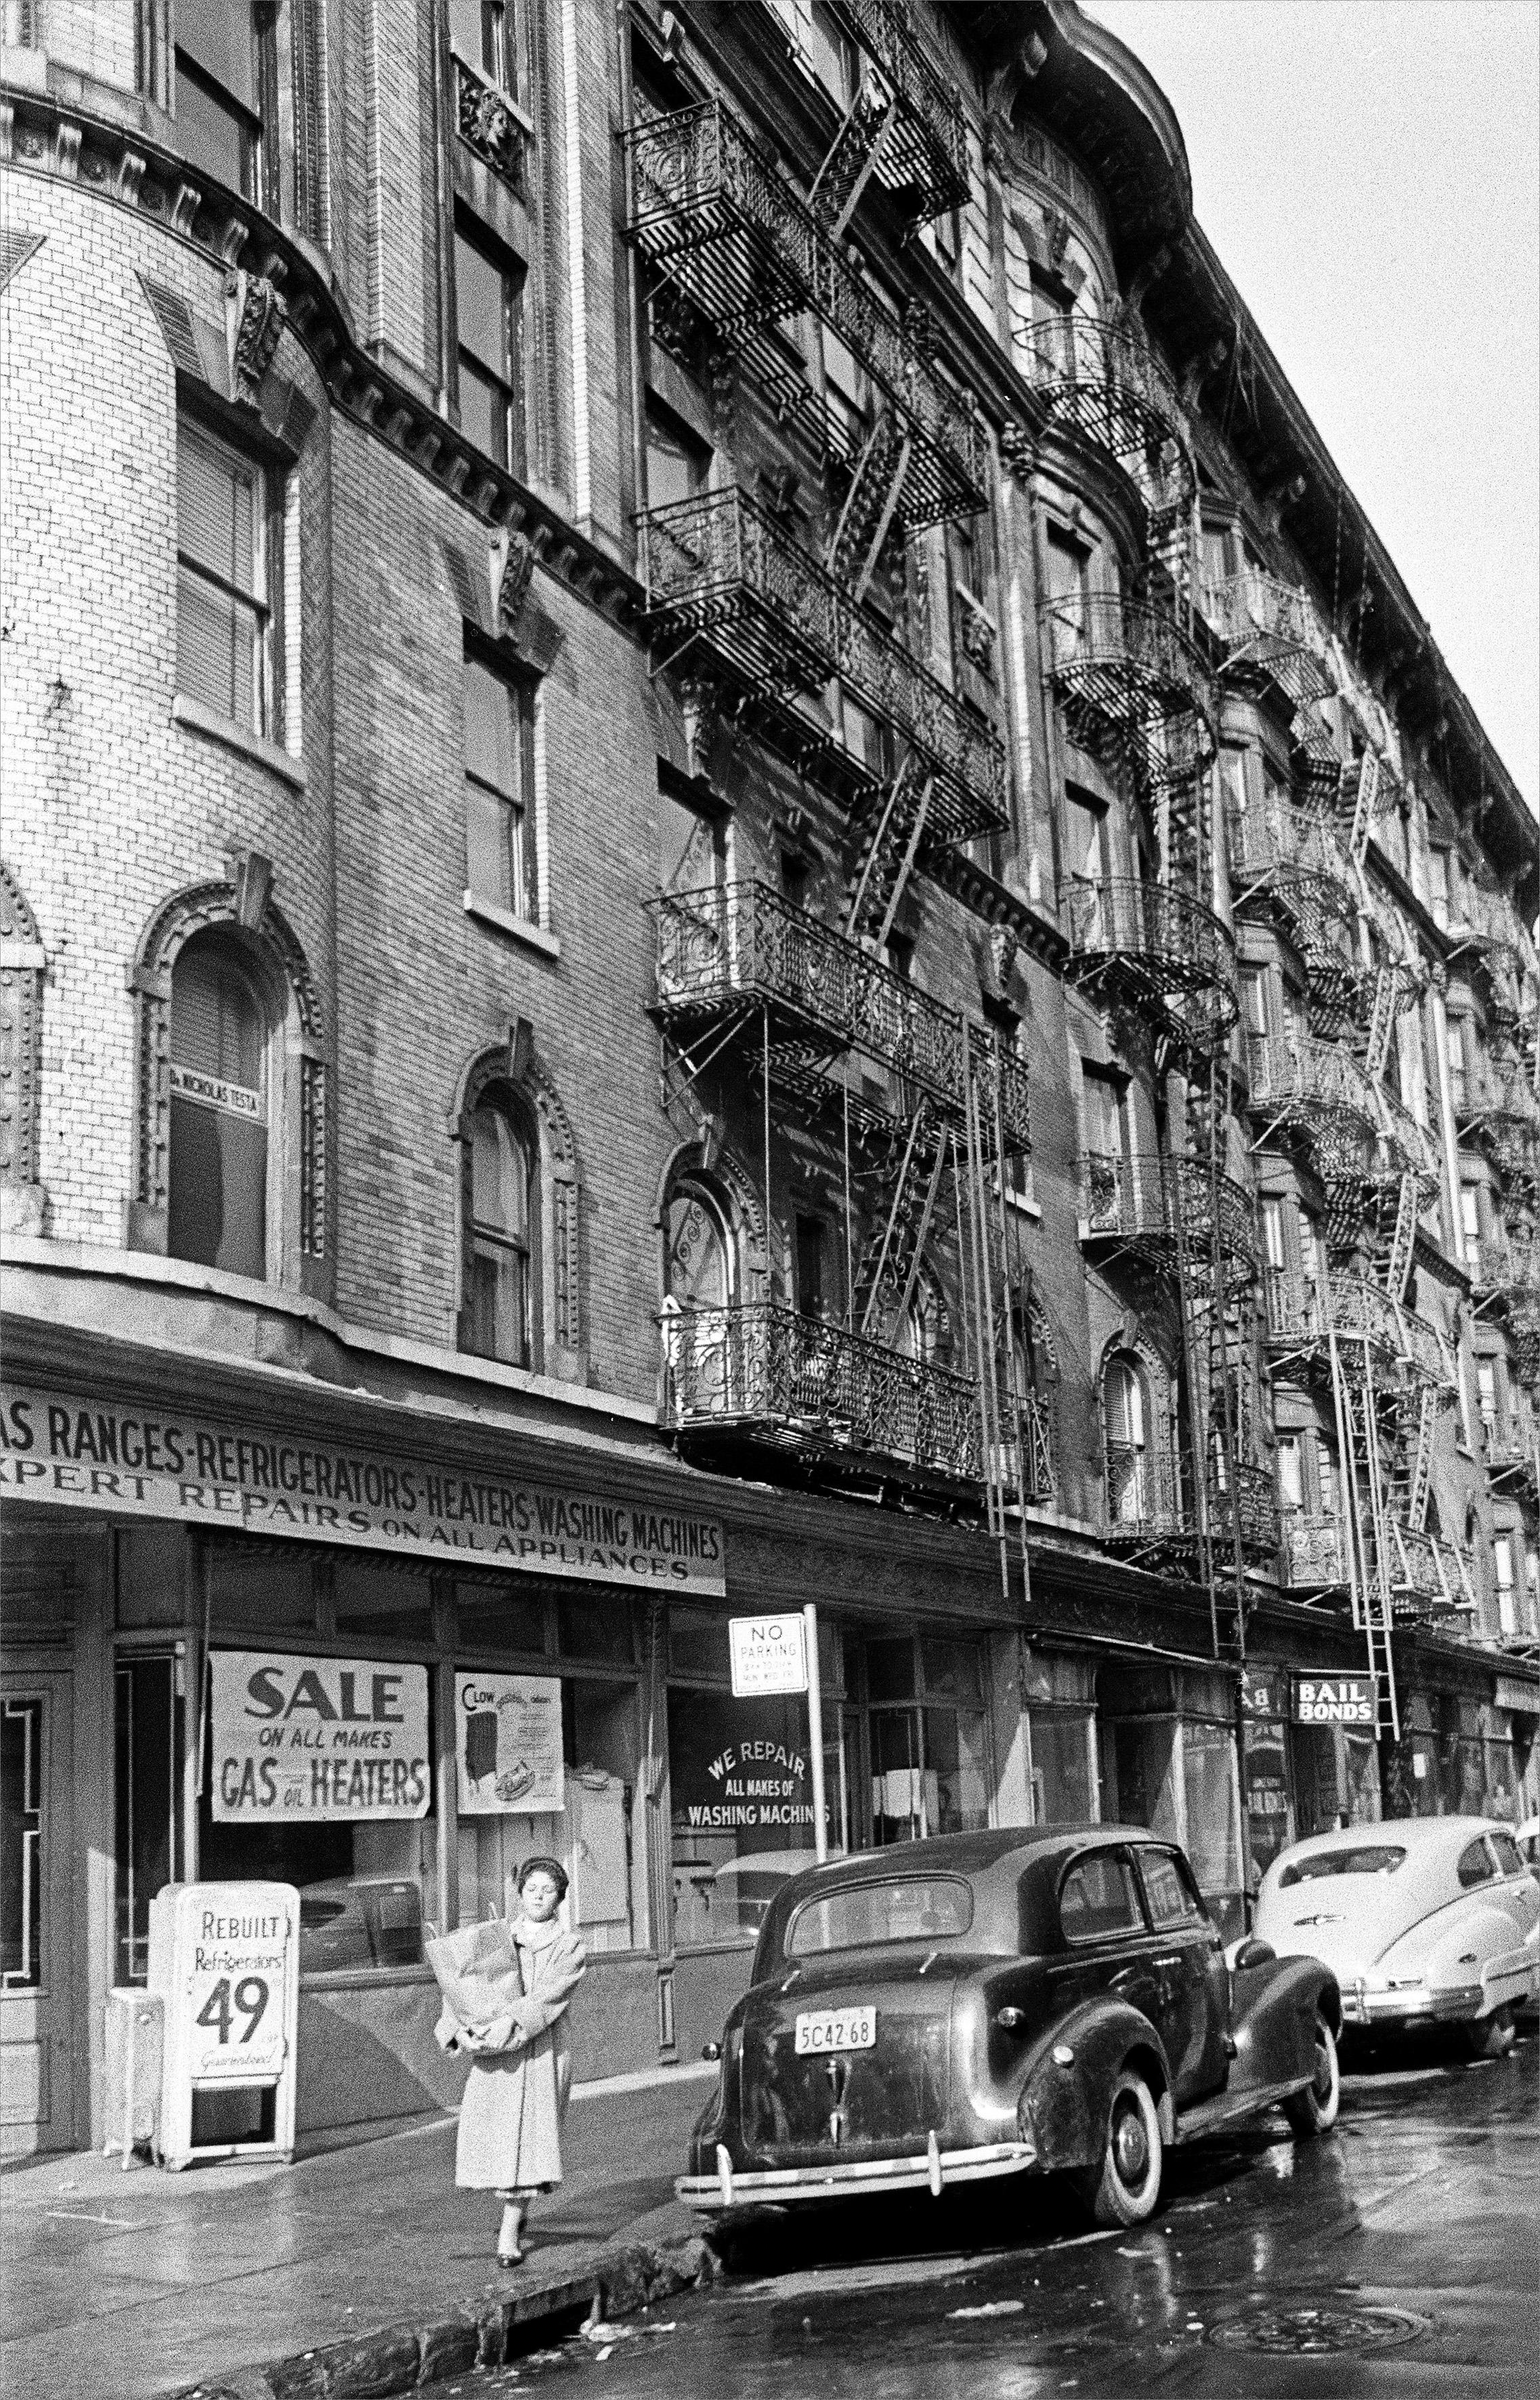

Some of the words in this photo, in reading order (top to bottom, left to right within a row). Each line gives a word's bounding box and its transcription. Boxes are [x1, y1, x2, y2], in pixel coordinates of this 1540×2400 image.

[48, 1405, 184, 1474] RANGES
[196, 1431, 416, 1512] REFRIGERATORS
[427, 1474, 529, 1532] HEATERS
[535, 1494, 628, 1547] WASHING
[632, 1513, 719, 1561] MACHINES
[179, 1483, 372, 1533] REPAIRS
[381, 1519, 421, 1540] ON
[430, 1526, 484, 1551] ALL
[495, 1534, 689, 1581] APPLIANCES
[750, 1624, 783, 1642] NO
[740, 1643, 796, 1659] PARKING
[244, 1666, 404, 1723] SALE
[461, 1683, 495, 1712] CLOW
[1299, 1683, 1367, 1702] BAIL
[1298, 1702, 1373, 1721] BONDS
[258, 1727, 285, 1747] ON
[289, 1728, 325, 1748] ALL
[333, 1729, 393, 1749] MAKES
[707, 1748, 737, 1781] WE
[740, 1741, 806, 1781] REPAIR
[221, 1756, 278, 1807] GAS
[311, 1757, 425, 1807] HEATERS
[725, 1779, 745, 1797] ALL
[747, 1779, 779, 1796] MAKES
[782, 1779, 794, 1796] OF
[688, 1805, 756, 1826] WASHING
[759, 1805, 830, 1826] MACHINS
[201, 1911, 279, 1940] REBUILT
[195, 1947, 283, 1973] Refrigerators
[195, 1975, 270, 2045] 49
